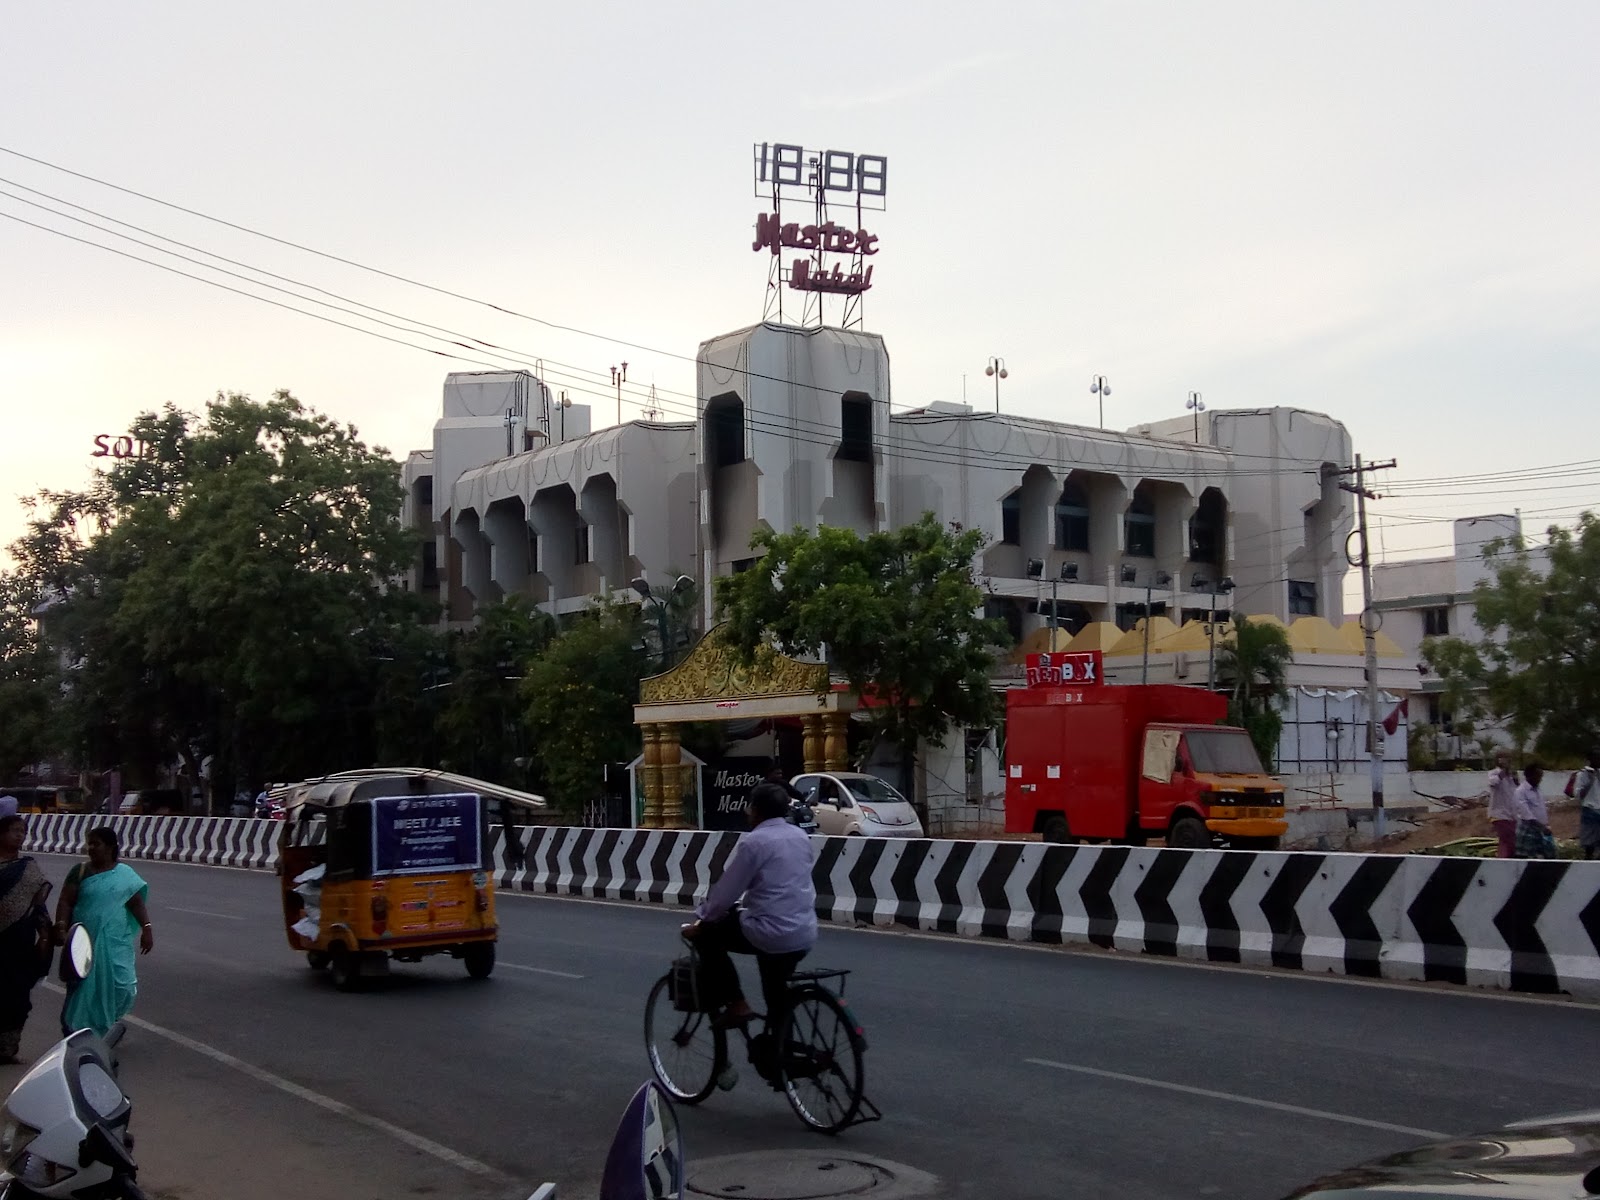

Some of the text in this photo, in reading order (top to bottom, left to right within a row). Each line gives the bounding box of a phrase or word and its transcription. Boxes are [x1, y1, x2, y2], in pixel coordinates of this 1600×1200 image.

[752, 213, 879, 255] Master
[789, 259, 874, 294] Mahal
[714, 770, 765, 789] Master
[717, 794, 753, 813] Mah
[437, 816, 461, 828] JEE
